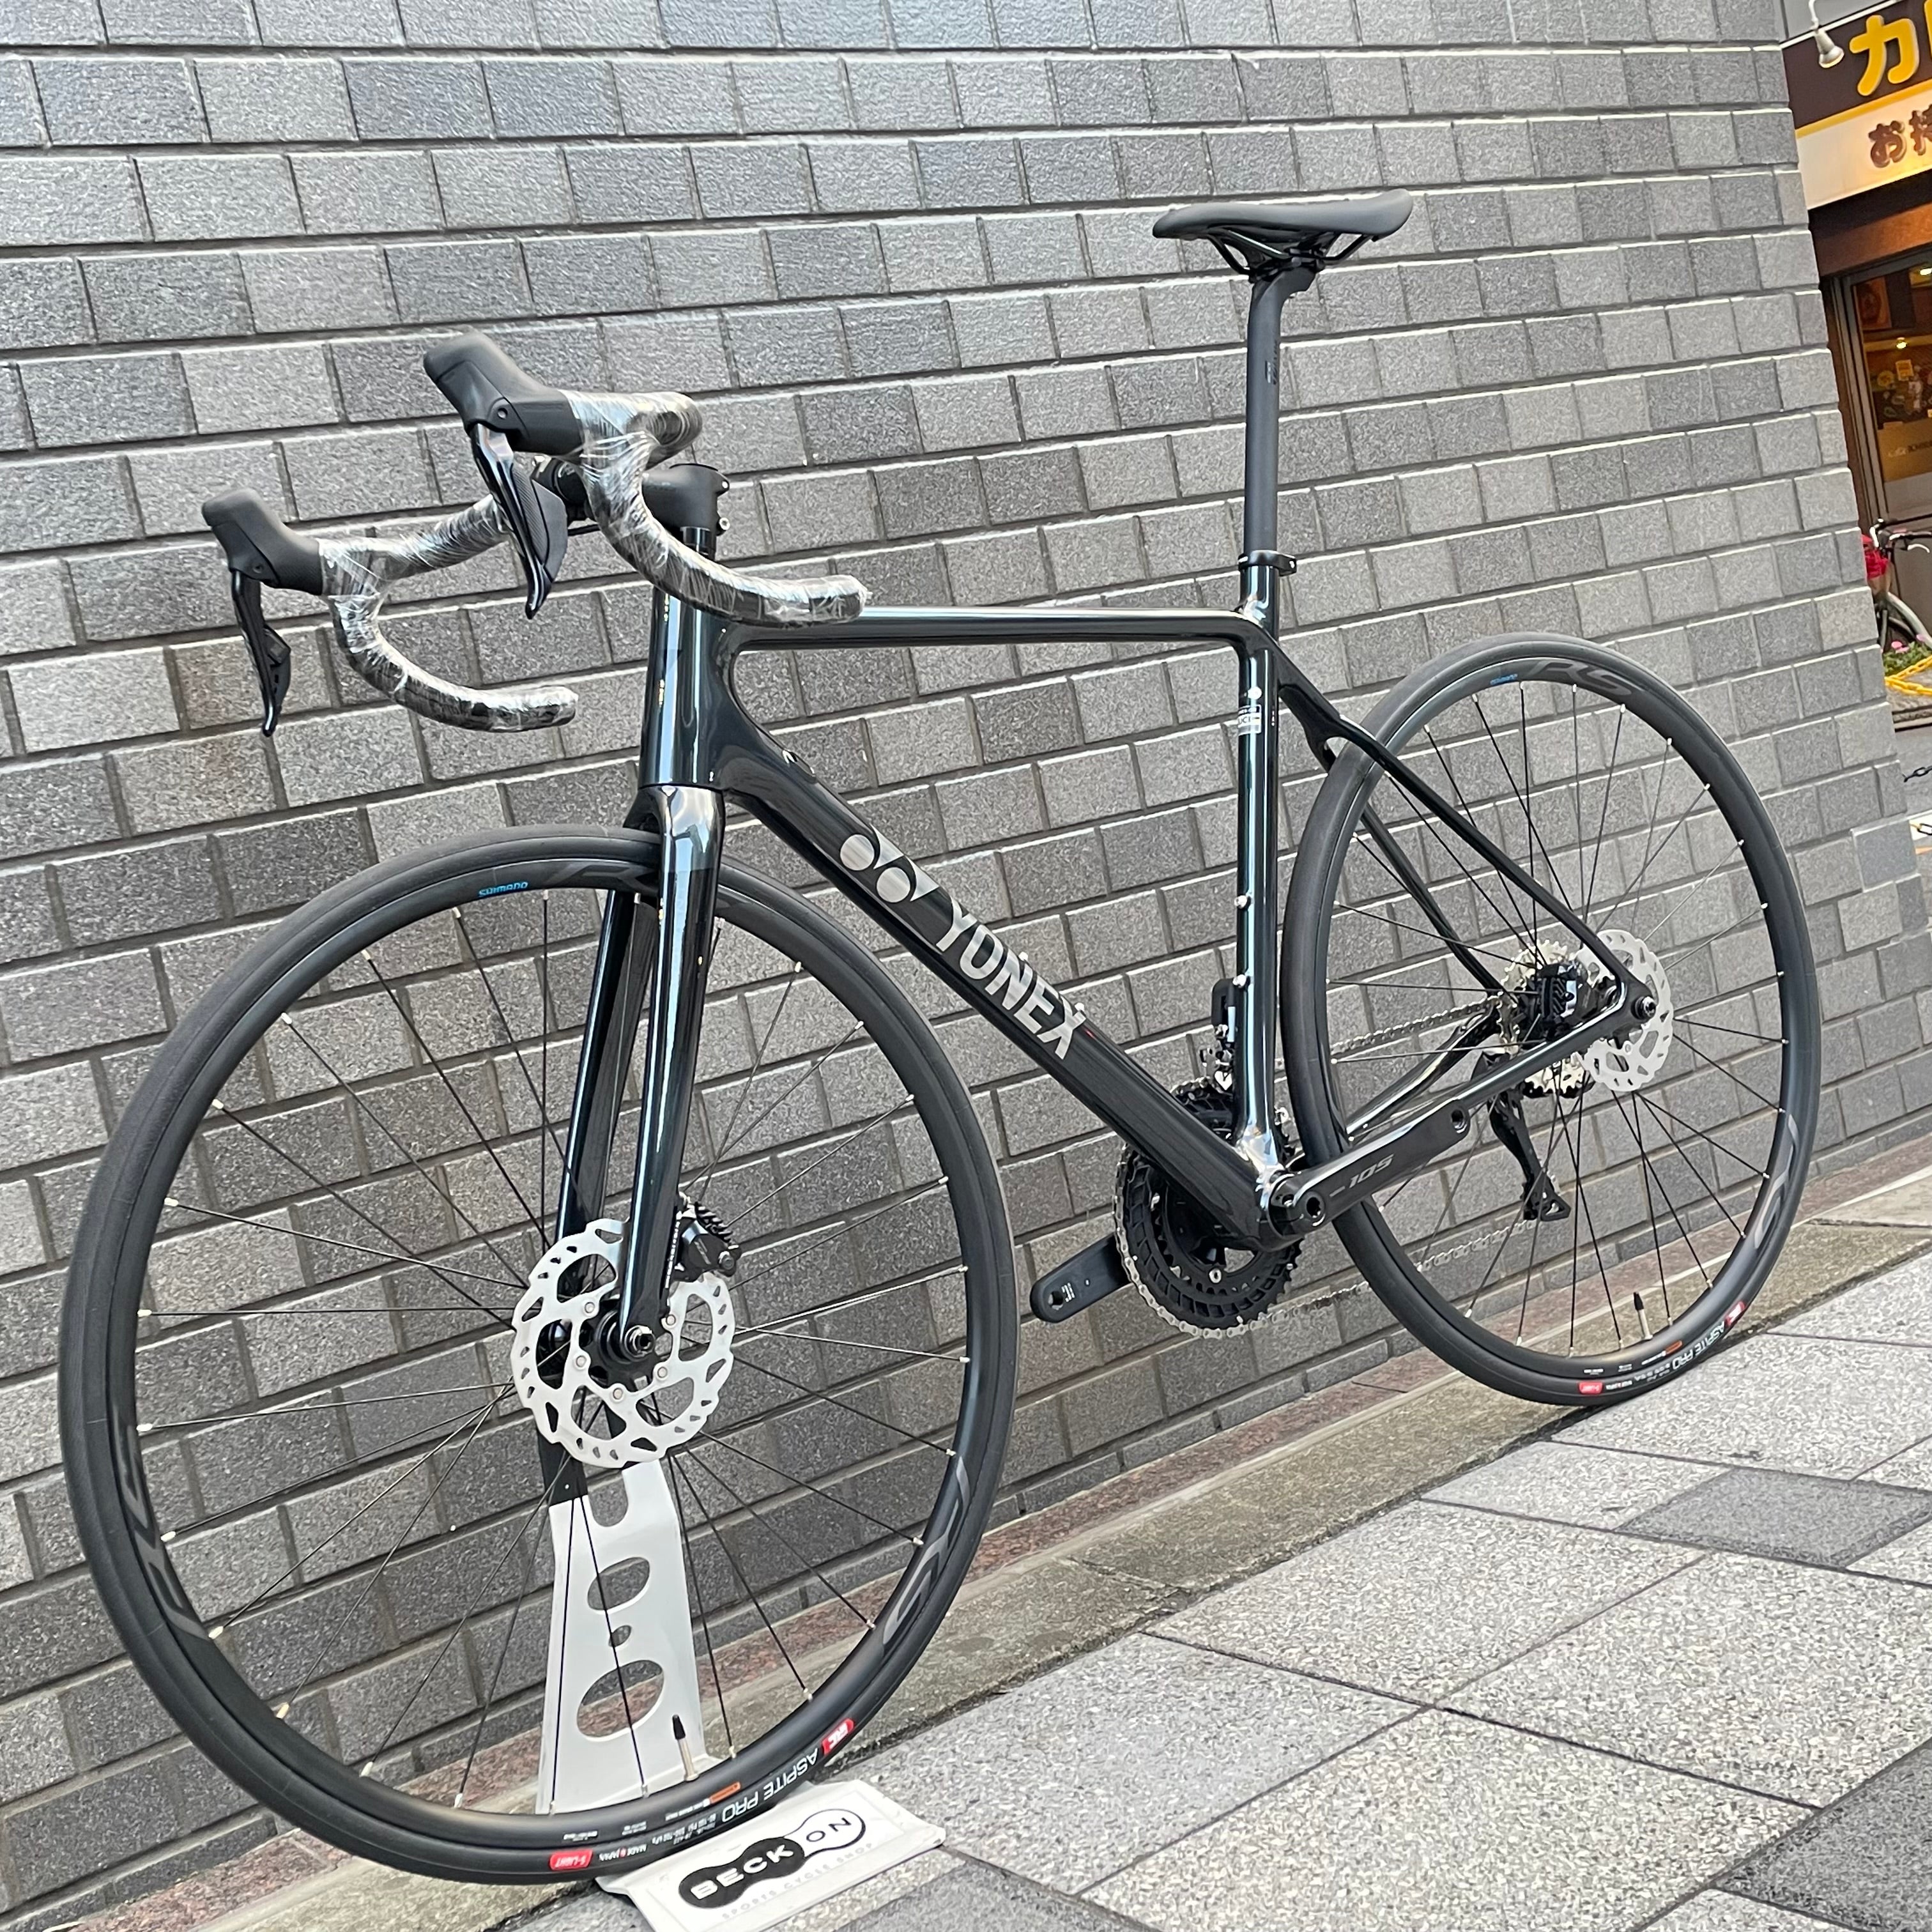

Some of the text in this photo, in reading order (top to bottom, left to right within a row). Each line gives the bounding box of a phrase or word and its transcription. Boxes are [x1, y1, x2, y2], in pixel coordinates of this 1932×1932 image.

[1849, 0, 1932, 96] カ
[936, 894, 1086, 1059] YONEX
[1672, 1349, 1693, 1370] PRO
[1694, 1321, 1724, 1356] ASPITE
[763, 1748, 818, 1800] ASPITE
[723, 1791, 758, 1822] PRO
[691, 1817, 852, 1900] BECK ON
